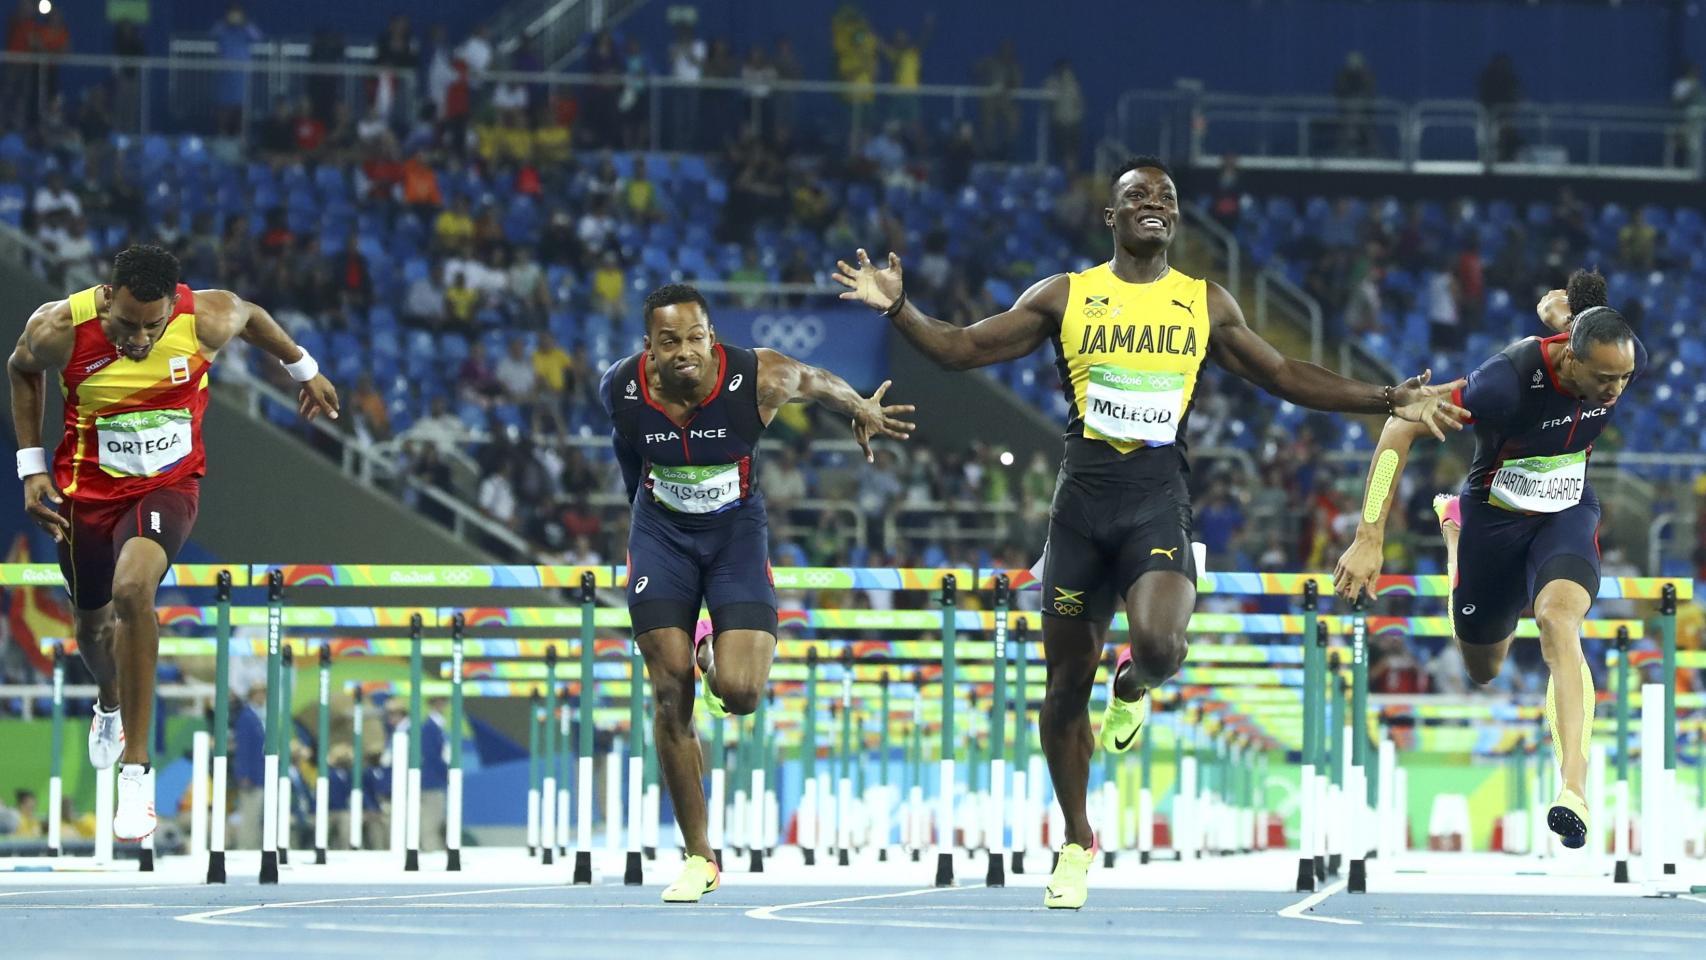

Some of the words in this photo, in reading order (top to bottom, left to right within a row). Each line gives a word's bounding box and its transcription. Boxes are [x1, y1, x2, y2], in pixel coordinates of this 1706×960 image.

[1078, 325, 1197, 357] JAMAICA
[1103, 372, 1142, 385] Rio2016
[1542, 408, 1606, 429] FRANCE
[107, 433, 181, 456] ORTEGA
[645, 428, 727, 444] FRANCE
[1493, 470, 1581, 501] MARTINOT-LAGARDE
